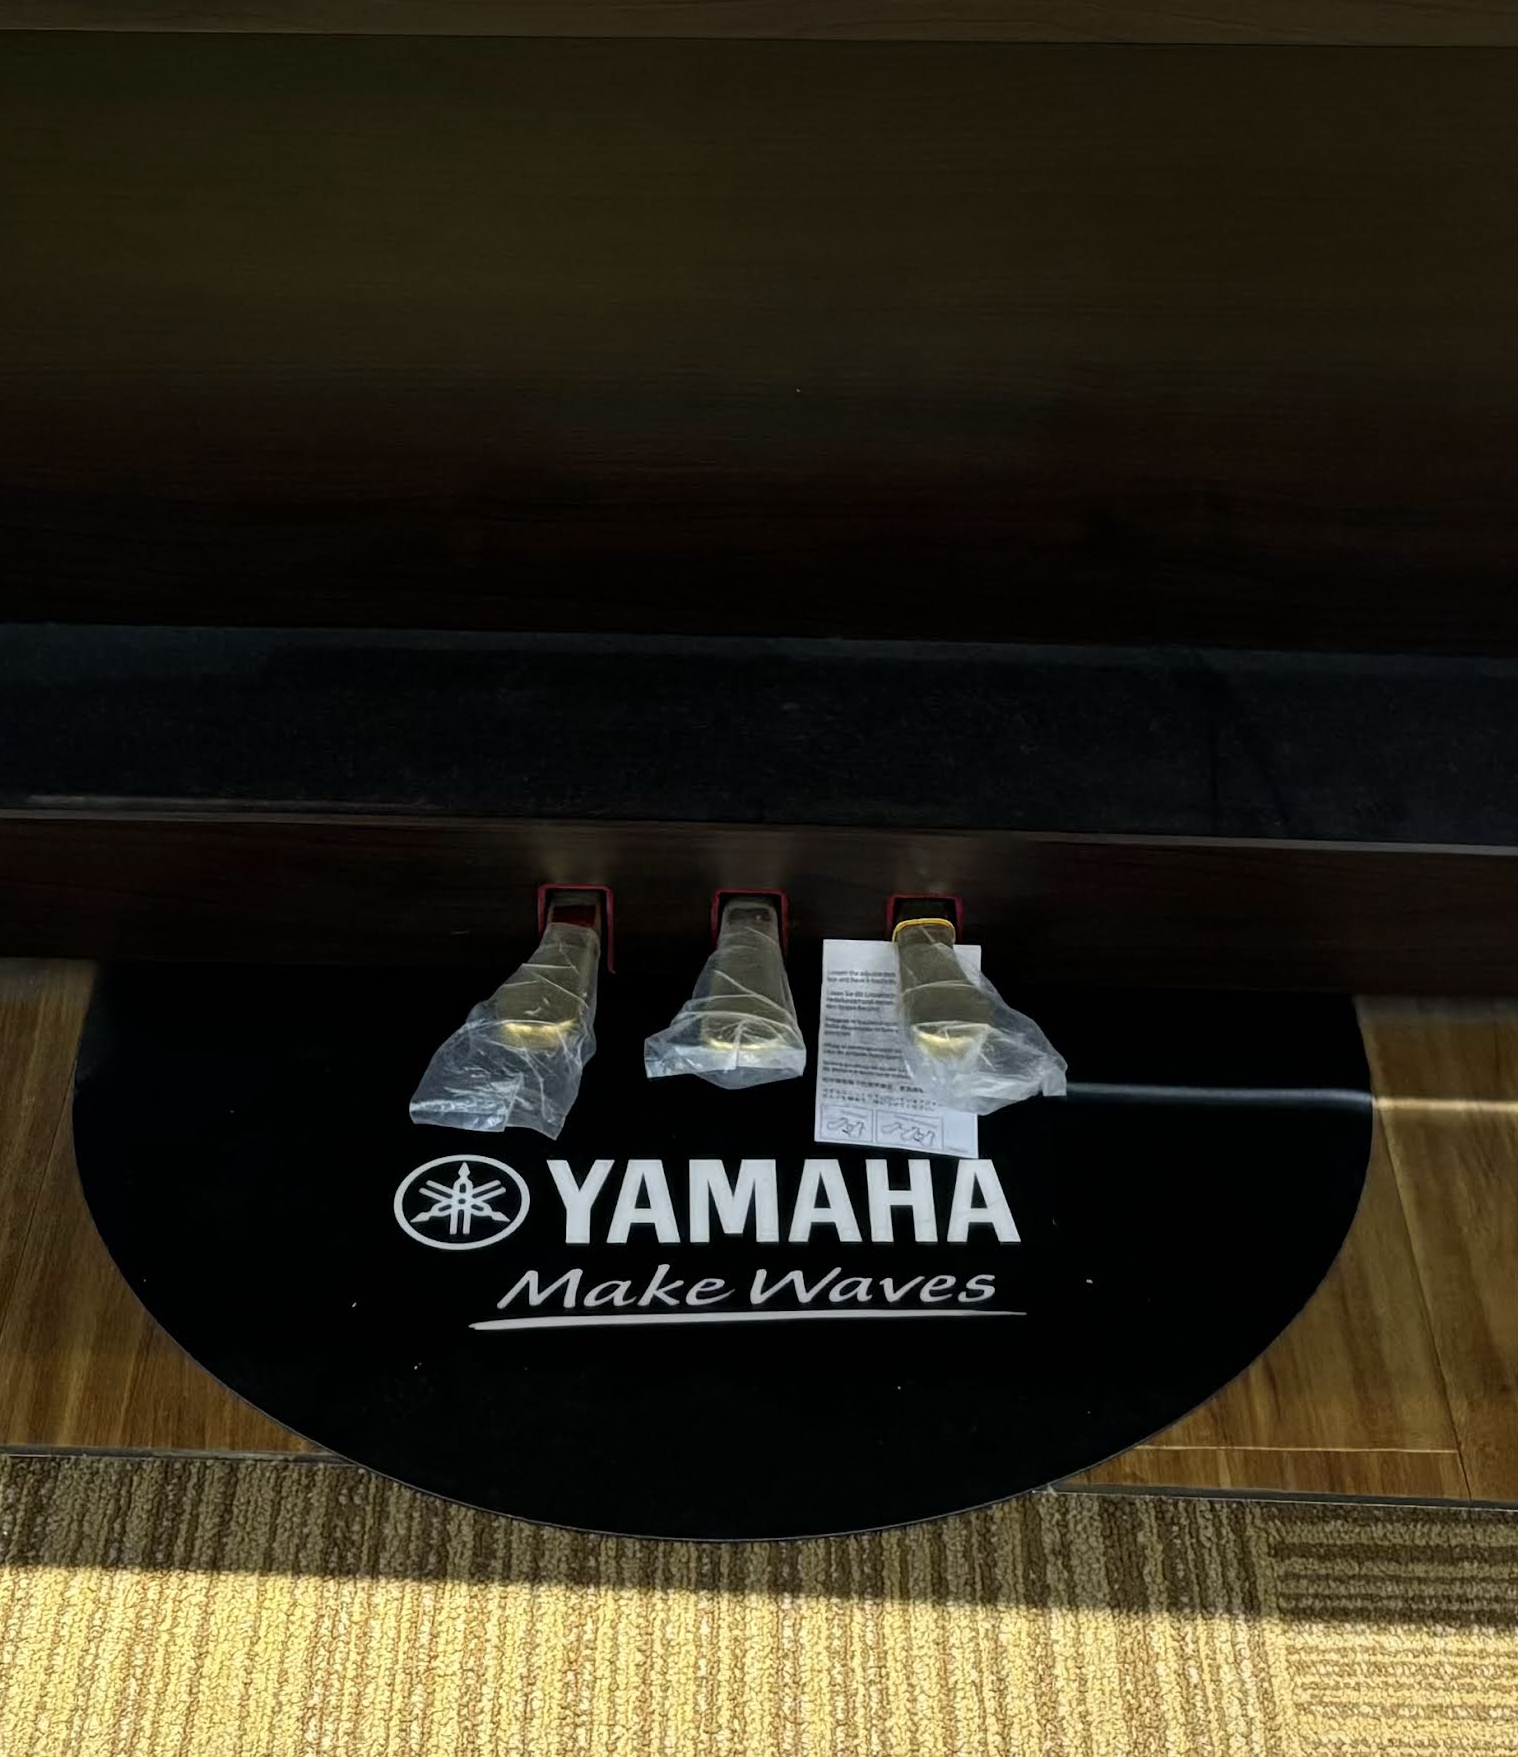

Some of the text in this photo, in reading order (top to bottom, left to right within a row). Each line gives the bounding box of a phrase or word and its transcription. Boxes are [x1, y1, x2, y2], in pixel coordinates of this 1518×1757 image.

[545, 1159, 1022, 1243] YAMAHA
[496, 1264, 996, 1310] Make Waves
